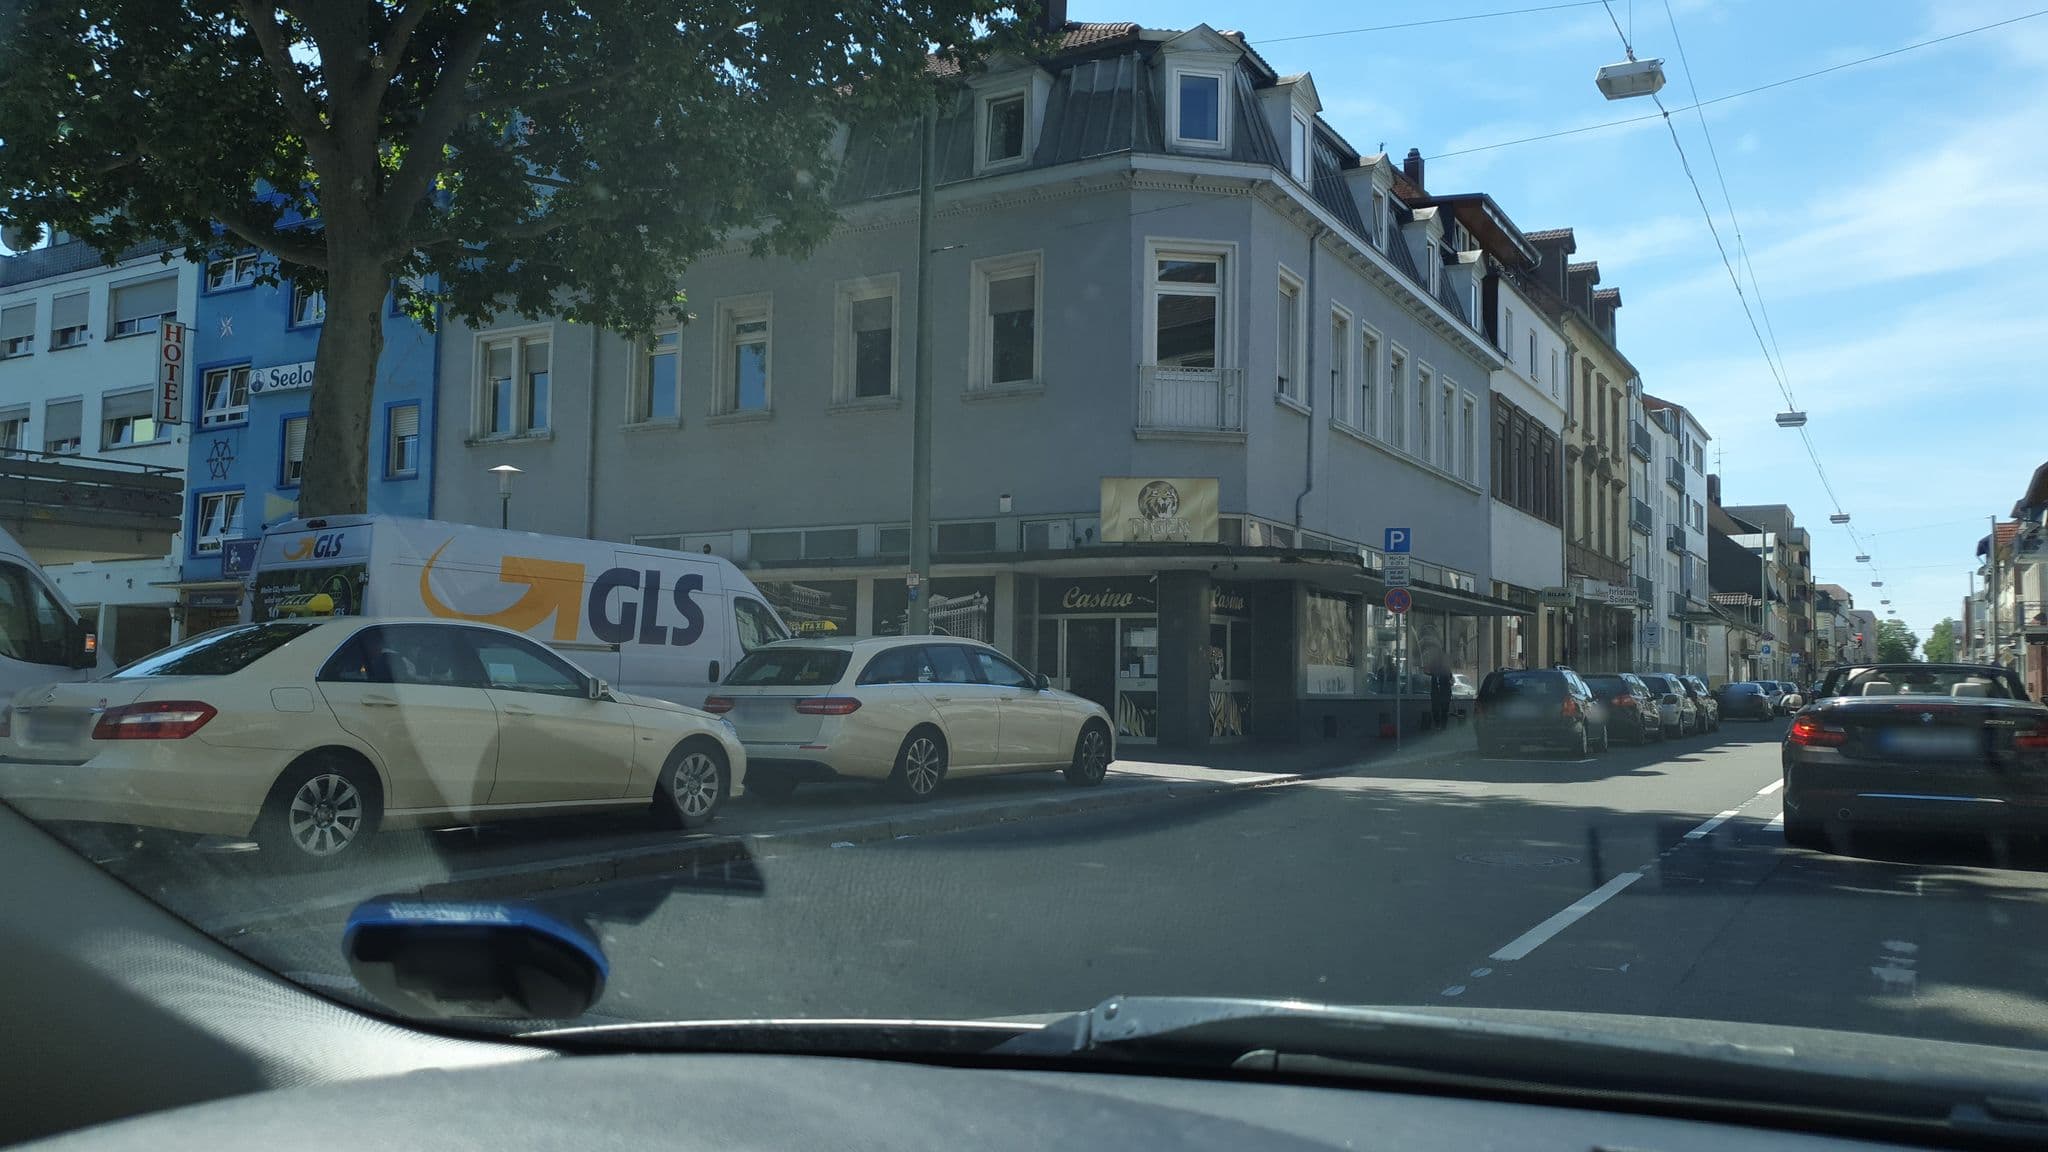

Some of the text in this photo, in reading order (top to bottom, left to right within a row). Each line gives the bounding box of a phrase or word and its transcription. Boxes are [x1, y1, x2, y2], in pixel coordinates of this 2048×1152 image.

[163, 324, 182, 420] HOTEL
[269, 365, 313, 388] Seelo
[314, 533, 344, 558] GLS
[1391, 531, 1404, 550] P
[588, 567, 704, 647] GLS
[1062, 586, 1133, 609] Casino
[1213, 585, 1244, 610] Casino
[804, 622, 825, 631] TAXI
